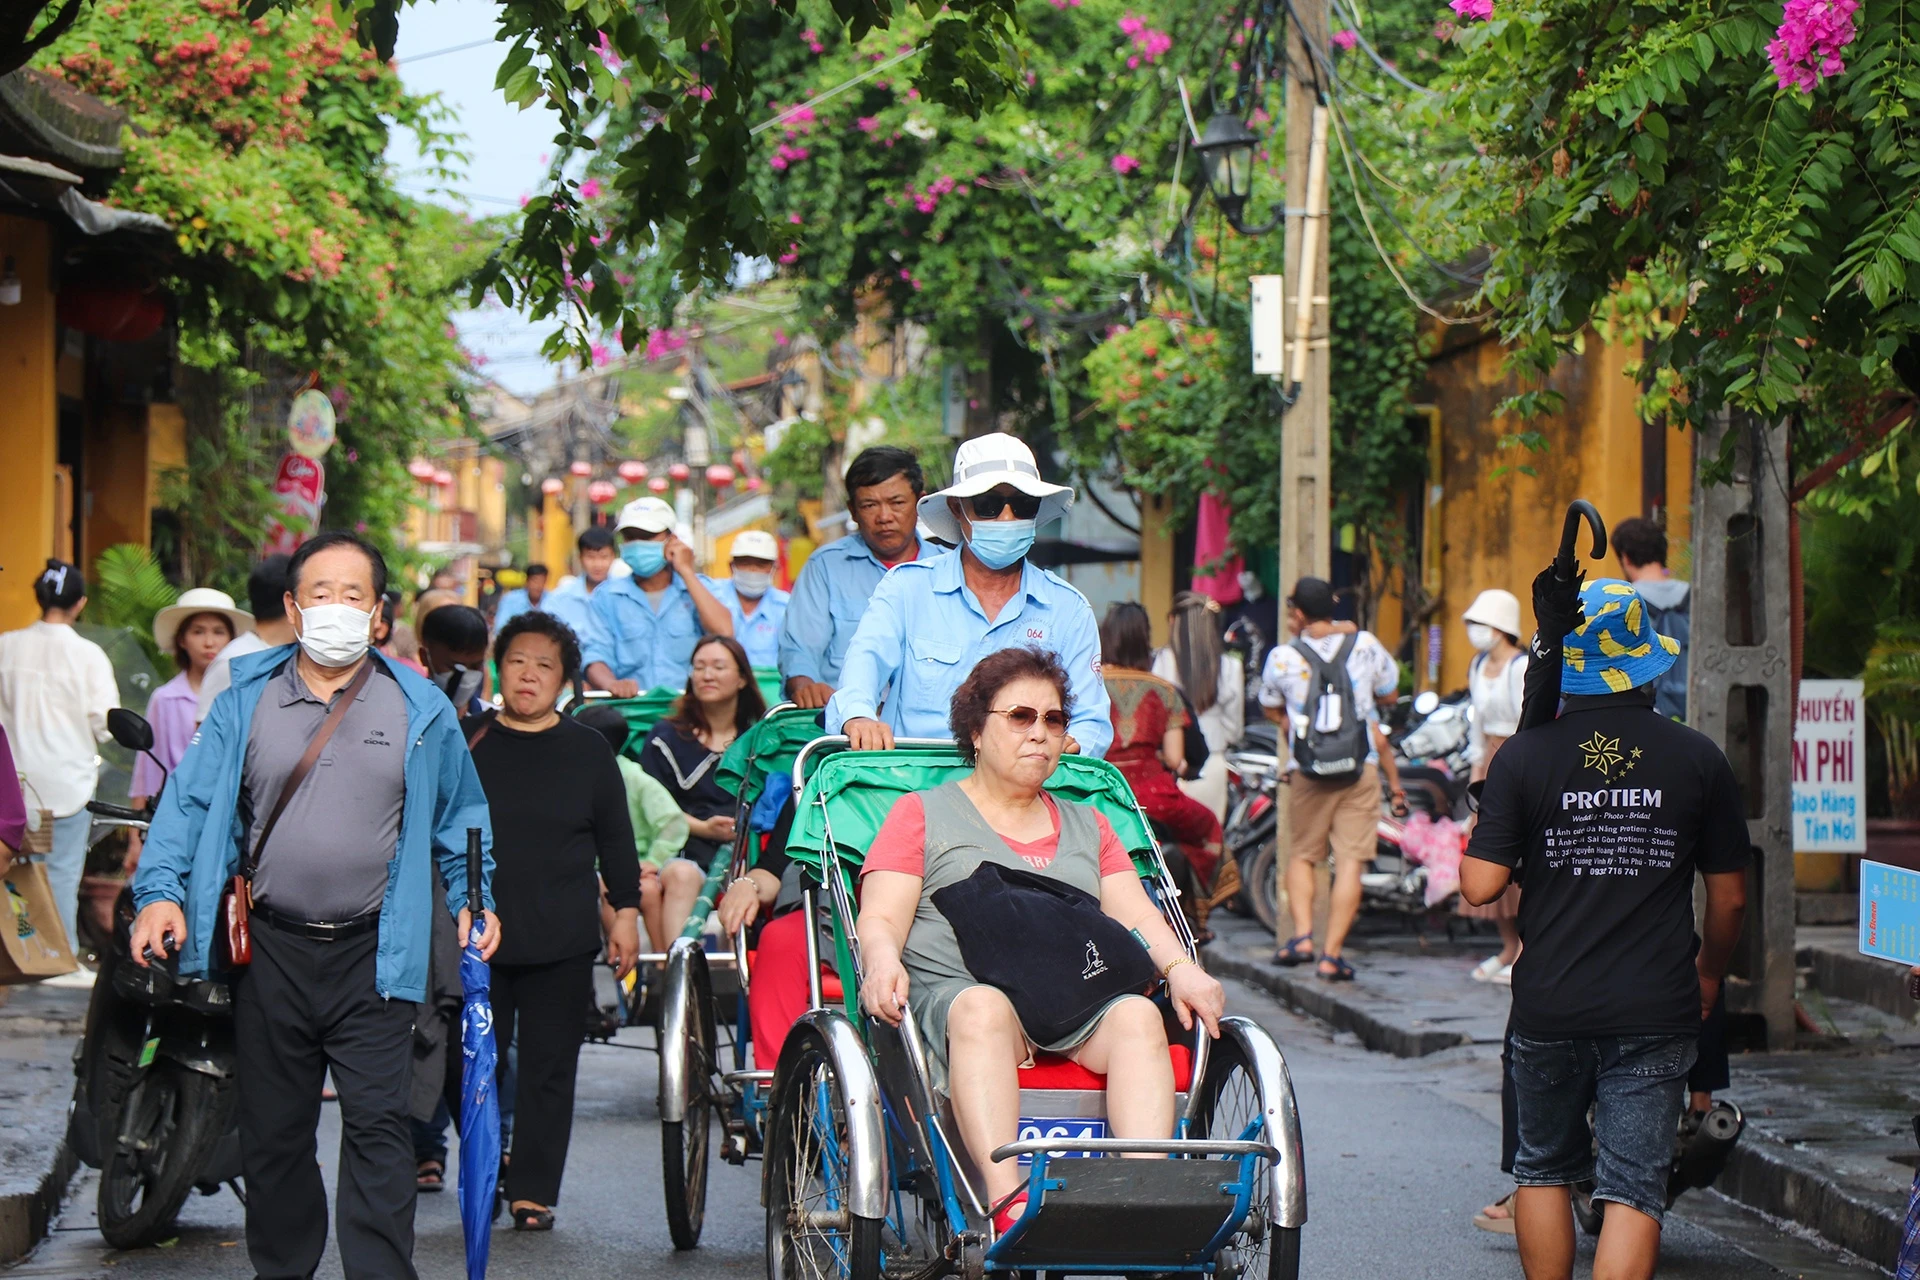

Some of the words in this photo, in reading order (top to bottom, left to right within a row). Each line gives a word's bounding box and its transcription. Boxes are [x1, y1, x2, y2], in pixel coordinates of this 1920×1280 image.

[1026, 628, 1043, 639] 064
[1817, 729, 1853, 783] PHÍ
[1562, 789, 1662, 810] PROTIEM
[1603, 812, 1624, 820] Photo
[1629, 811, 1652, 820] Bridal
[1620, 825, 1647, 833] Protiem
[1654, 827, 1678, 836] Studio
[1617, 836, 1644, 844] Protiem
[1651, 838, 1675, 847] Studio
[1648, 859, 1671, 868] TP.HCM
[1624, 867, 1639, 876] 741
[1868, 932, 1876, 947] Five
[1083, 966, 1109, 980] KANGOL
